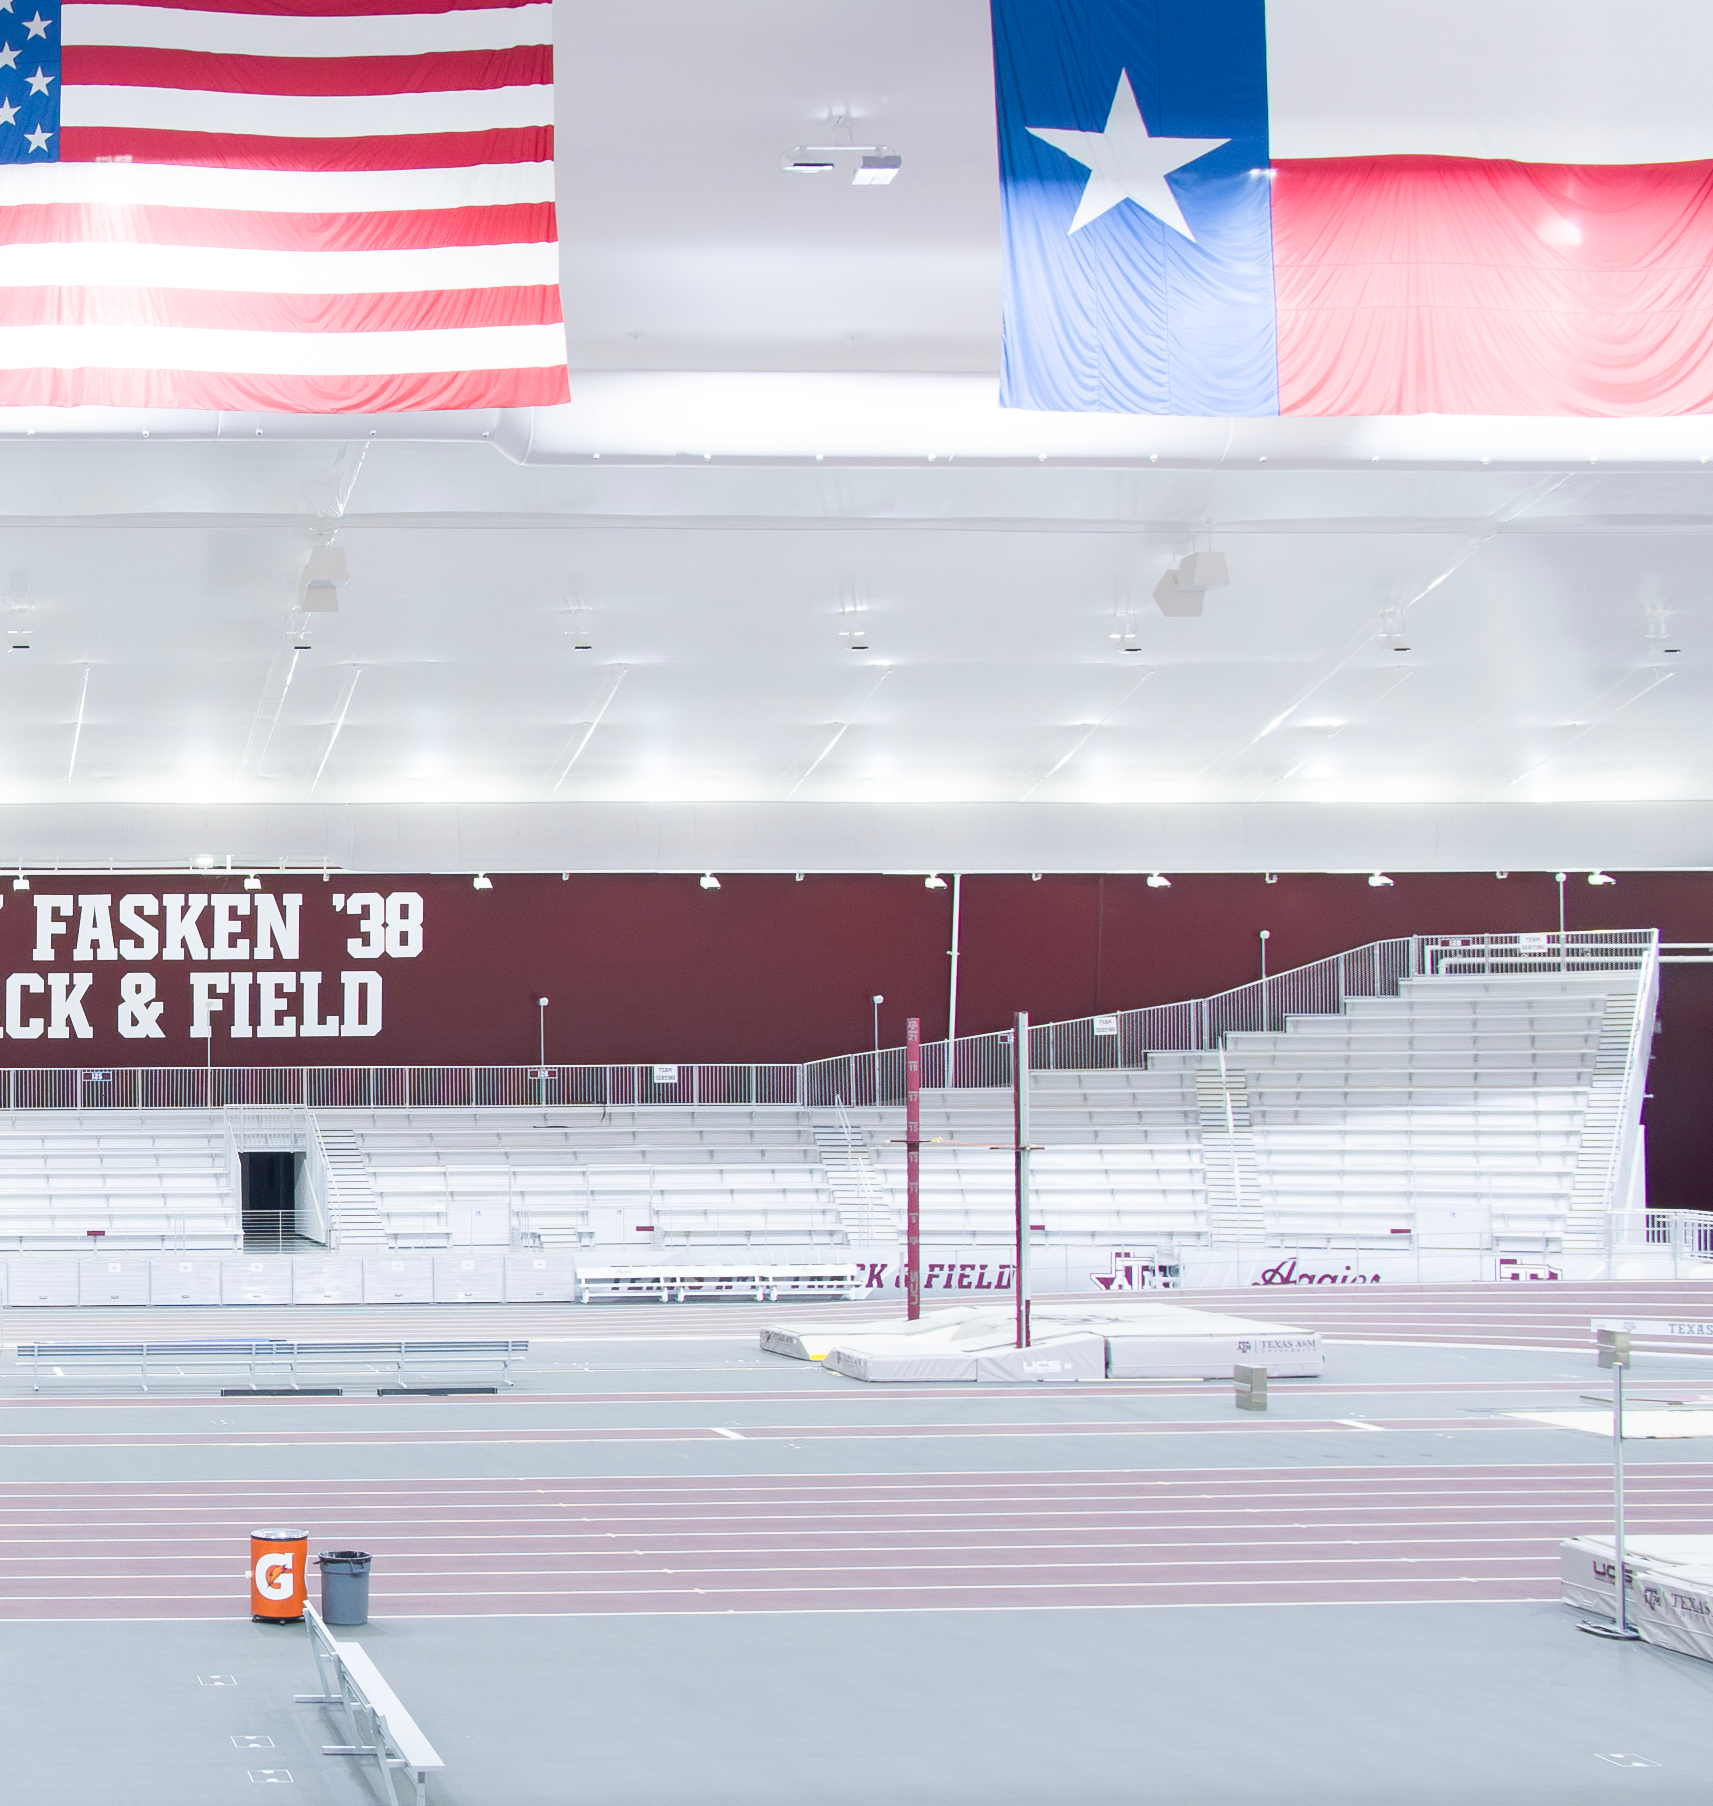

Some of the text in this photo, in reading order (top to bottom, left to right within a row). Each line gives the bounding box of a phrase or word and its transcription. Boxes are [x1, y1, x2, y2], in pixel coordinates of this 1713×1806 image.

[33, 894, 302, 961] FASKEN
[333, 892, 424, 958] '38
[118, 972, 164, 1039] &
[190, 970, 382, 1038] FIELD
[924, 1264, 1017, 1290] FIELD
[255, 1552, 294, 1600] G
